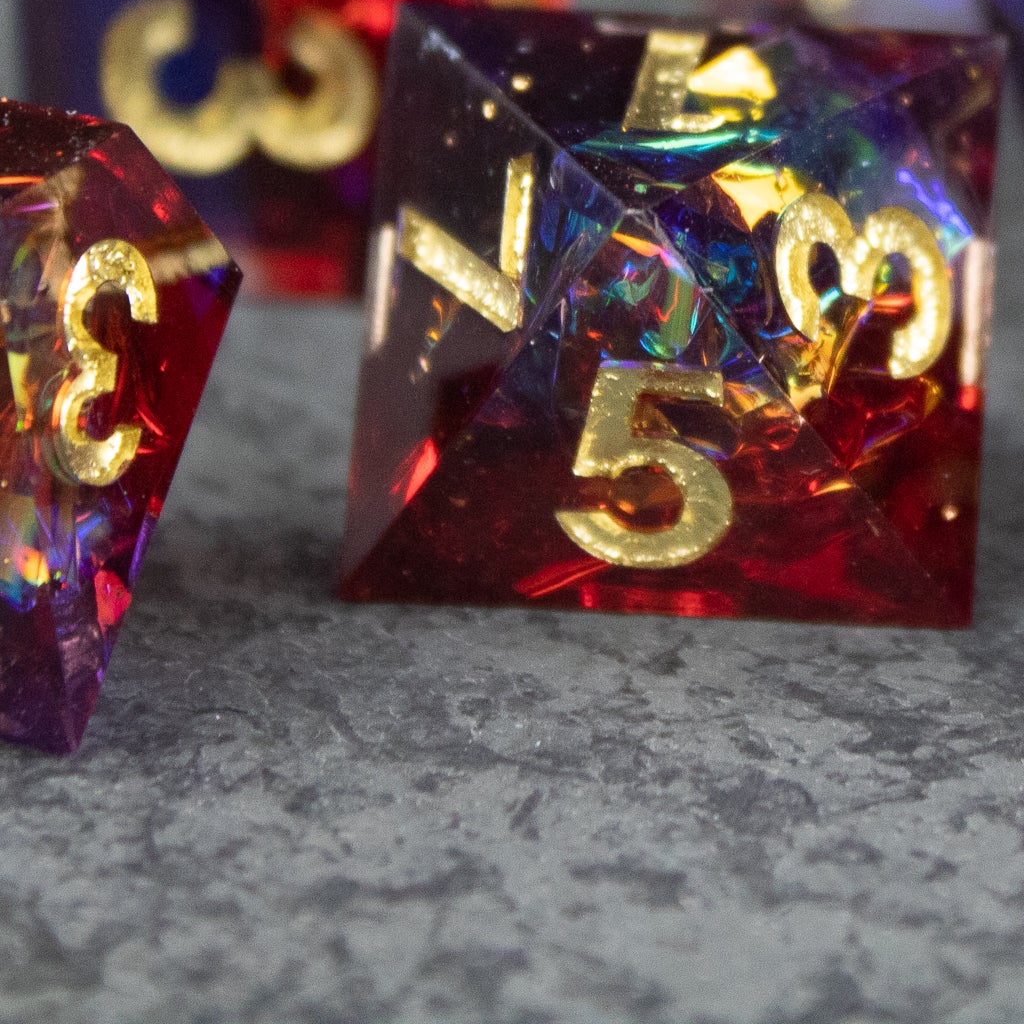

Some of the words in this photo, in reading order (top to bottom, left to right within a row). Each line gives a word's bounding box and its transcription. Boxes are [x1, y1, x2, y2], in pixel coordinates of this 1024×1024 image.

[59, 238, 158, 486] 3
[776, 193, 951, 380] 3
[555, 363, 733, 569] 5
